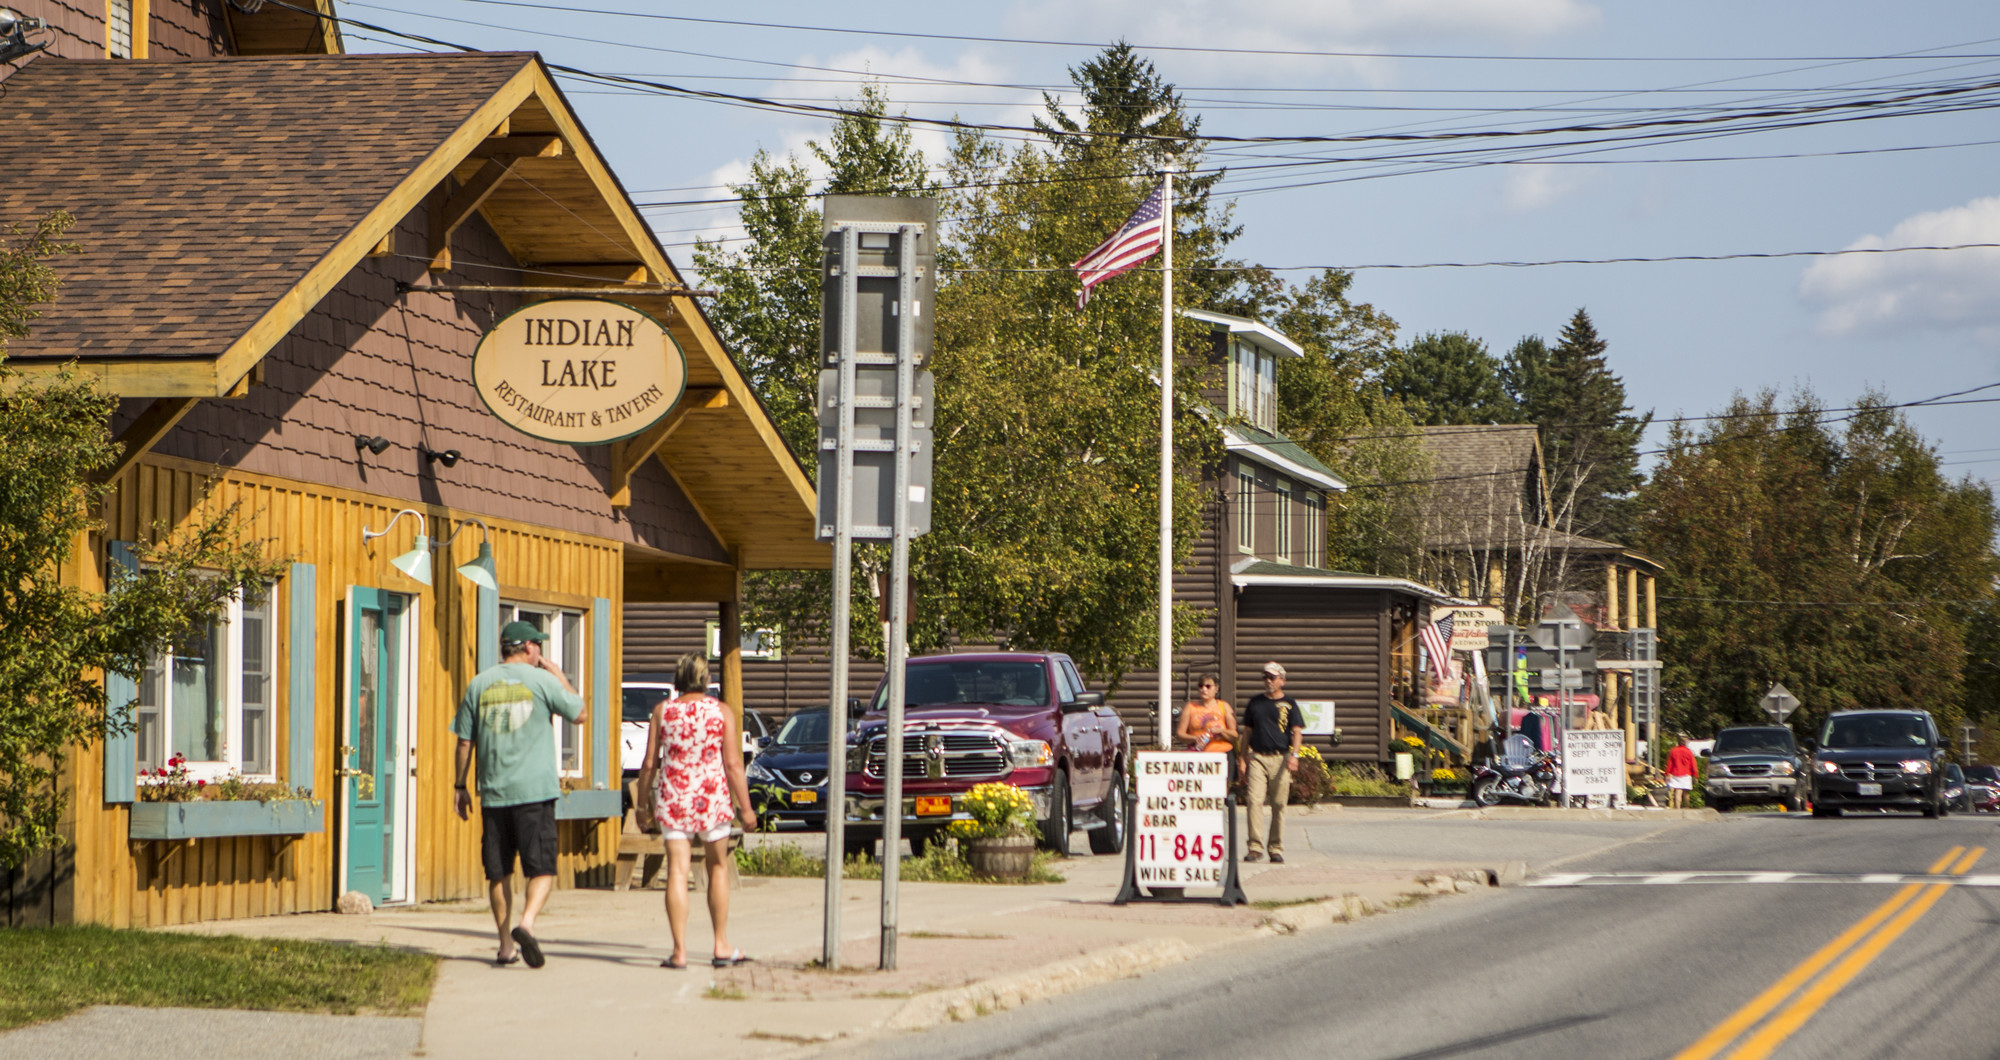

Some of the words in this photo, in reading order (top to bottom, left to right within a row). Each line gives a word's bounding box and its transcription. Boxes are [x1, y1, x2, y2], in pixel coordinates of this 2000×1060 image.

[524, 318, 635, 347] INDIAN
[541, 359, 617, 390] LAKE
[494, 379, 585, 428] RESTAURANT
[591, 411, 602, 427] &
[605, 383, 664, 423] TAVERN
[1582, 732, 1621, 740] MOUNTAINS
[1145, 762, 1221, 775] ESTAURANT
[1571, 768, 1594, 776] MOOSE
[1167, 780, 1202, 792] OPEN
[1140, 868, 1176, 881] WINE
[1185, 868, 1220, 882] SALE
